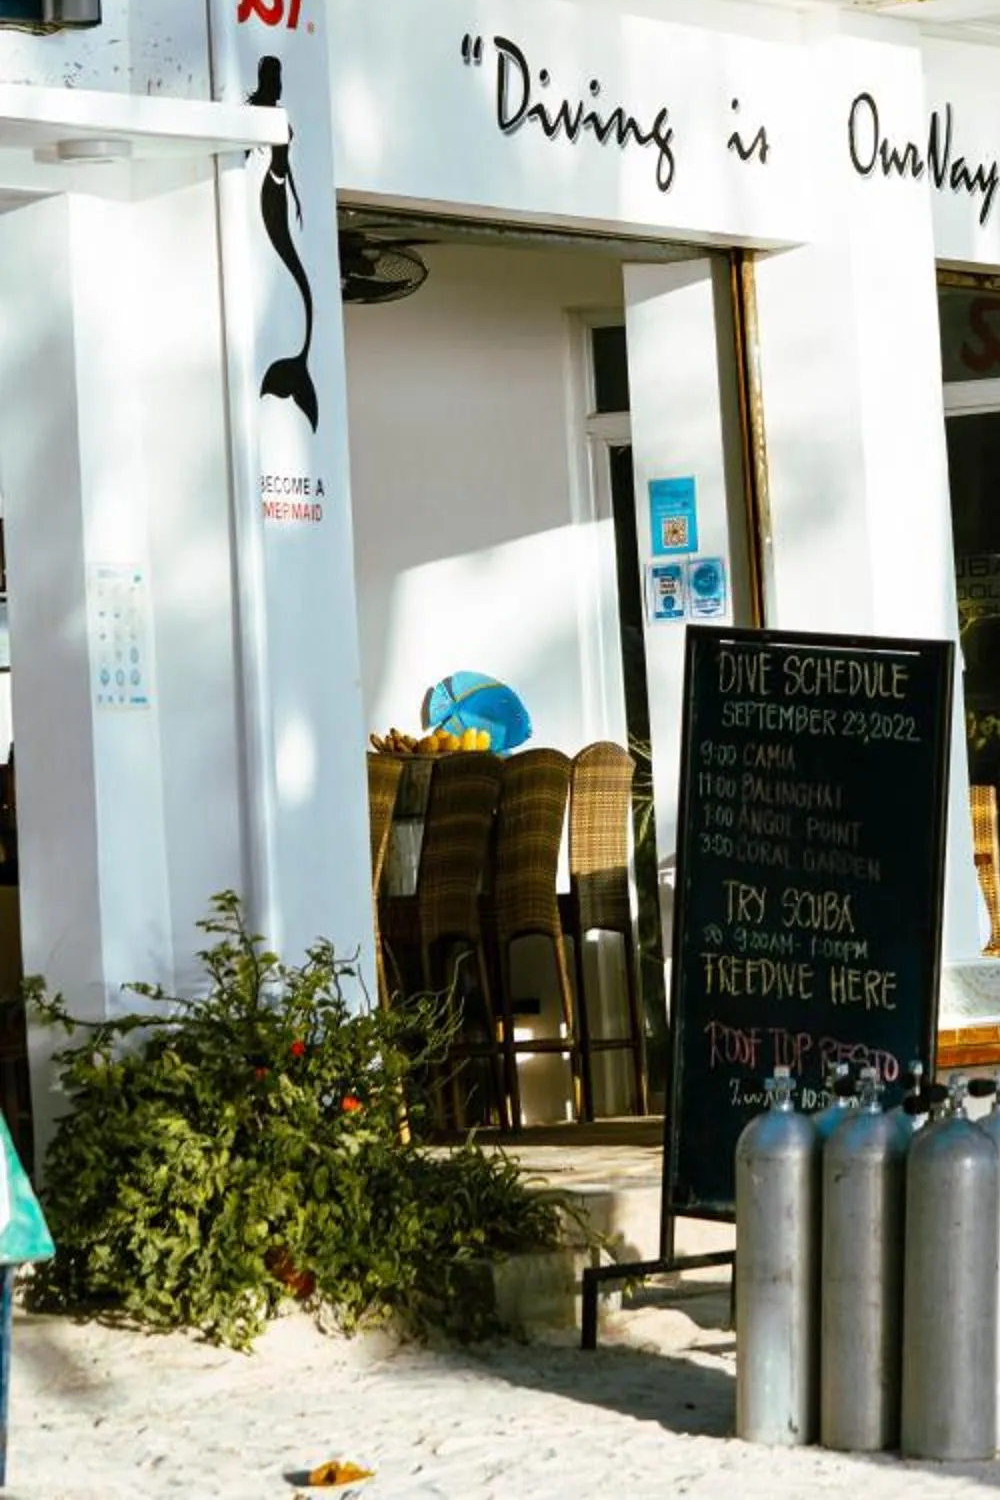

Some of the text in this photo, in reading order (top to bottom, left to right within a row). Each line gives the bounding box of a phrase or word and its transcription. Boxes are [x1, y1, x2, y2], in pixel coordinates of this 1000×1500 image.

[461, 32, 675, 192] "Diving
[727, 97, 770, 164] is
[847, 91, 925, 178] Our
[718, 651, 910, 700] DIVE SCHEDULE
[721, 700, 836, 736] SEPTEMBER
[806, 816, 864, 849] POINT
[722, 879, 856, 934] TRY SCUBA
[700, 952, 898, 1010] FREEDIVE HERE
